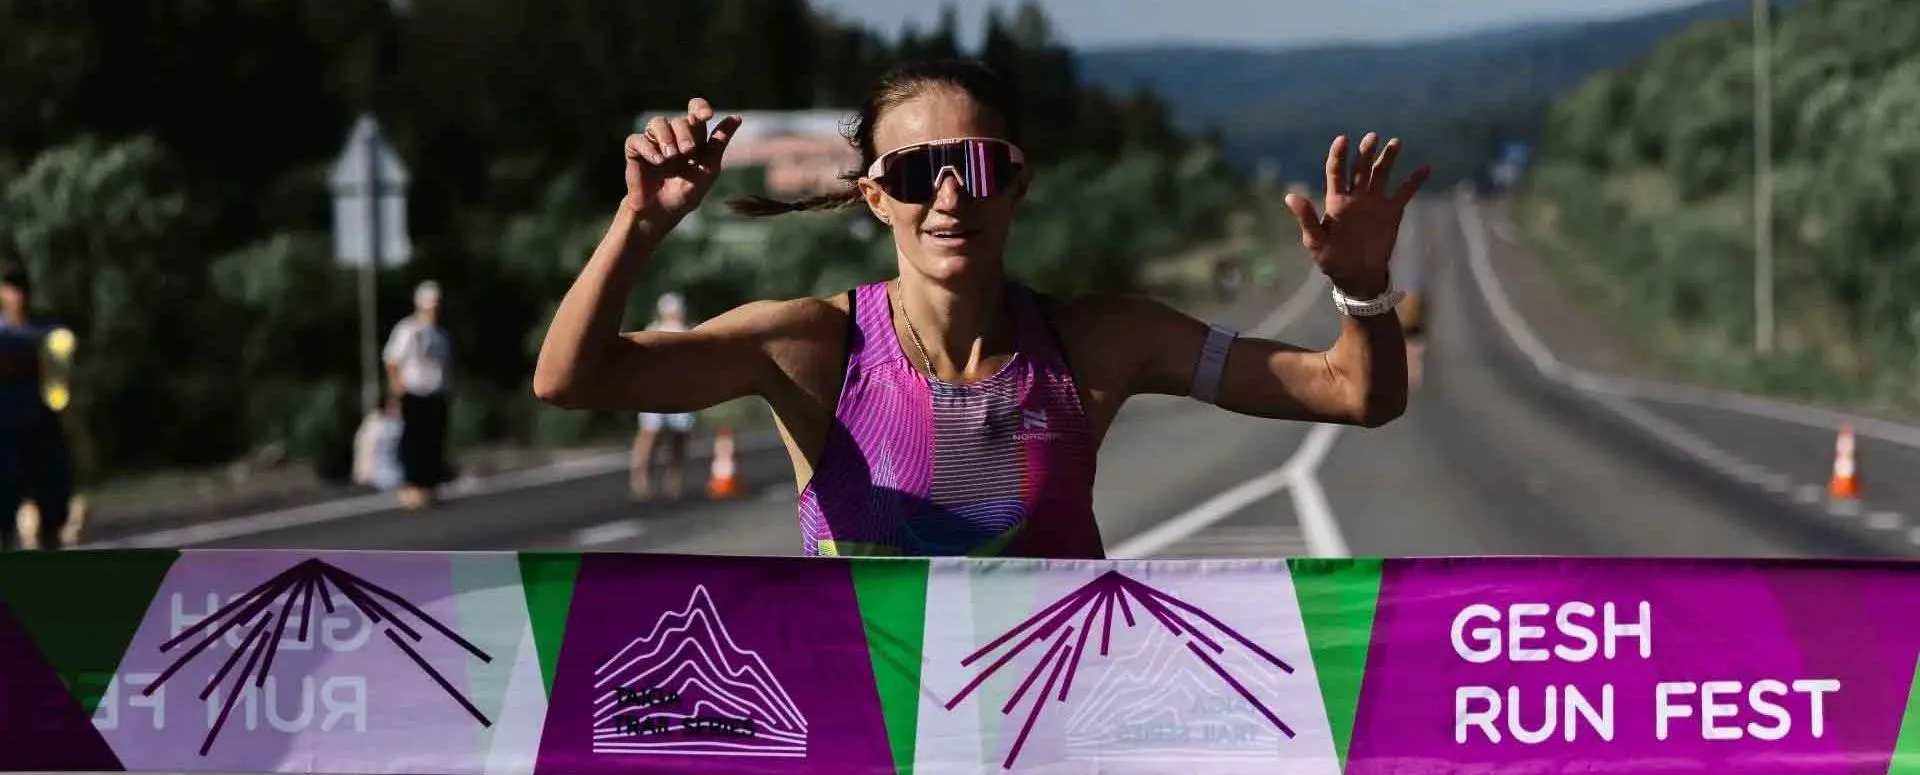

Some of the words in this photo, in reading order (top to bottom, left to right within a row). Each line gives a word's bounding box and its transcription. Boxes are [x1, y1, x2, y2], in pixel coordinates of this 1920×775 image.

[1450, 600, 1651, 663] GESH
[1455, 683, 1614, 744] RUN
[1655, 679, 1841, 741] FEST
